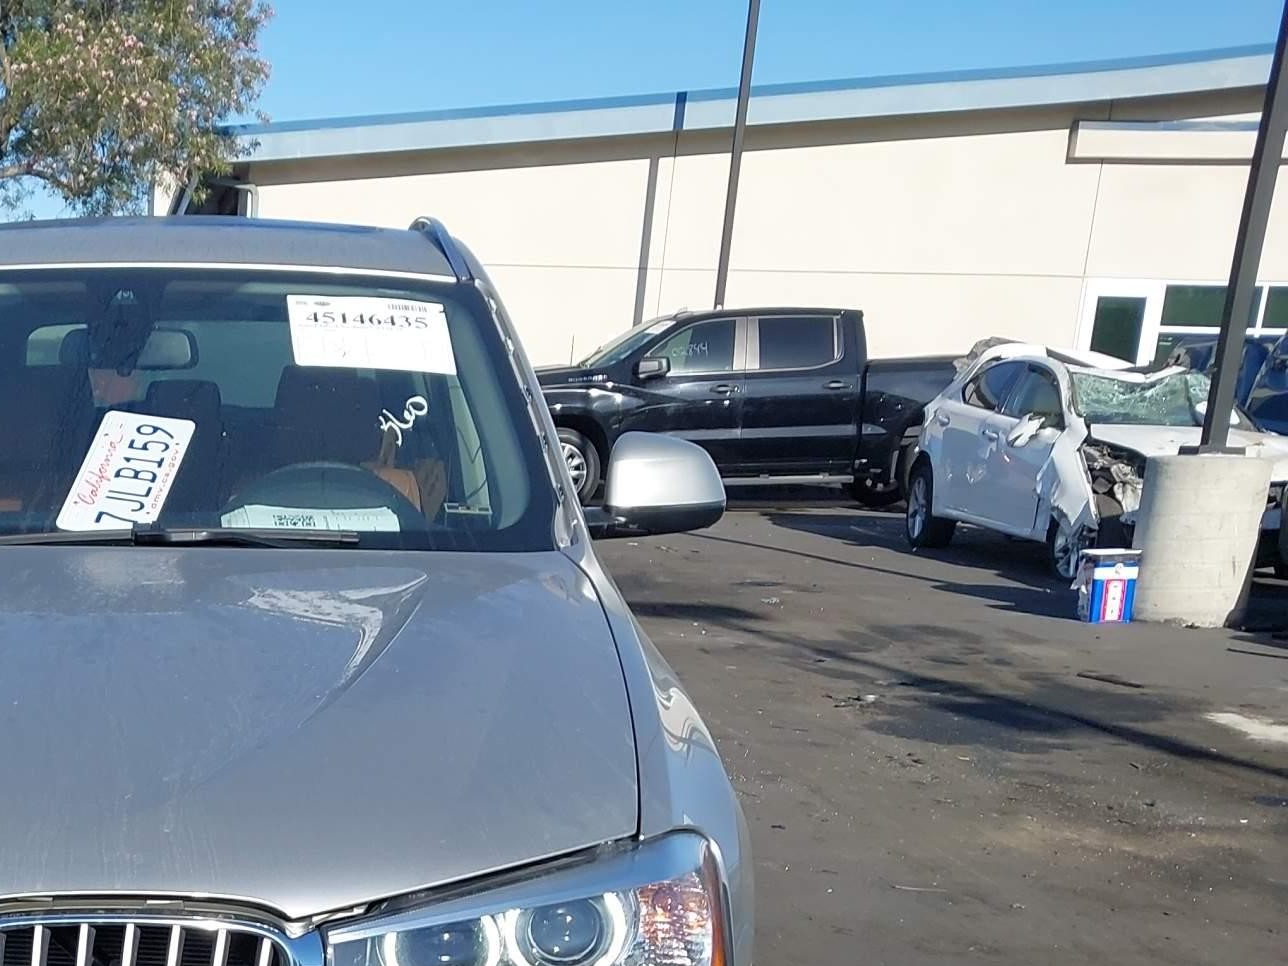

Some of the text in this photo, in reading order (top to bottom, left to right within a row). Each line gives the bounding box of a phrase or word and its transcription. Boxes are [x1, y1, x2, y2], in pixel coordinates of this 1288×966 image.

[305, 311, 429, 330] 45146435
[77, 434, 124, 506] California
[94, 423, 175, 524] 7JLB159
